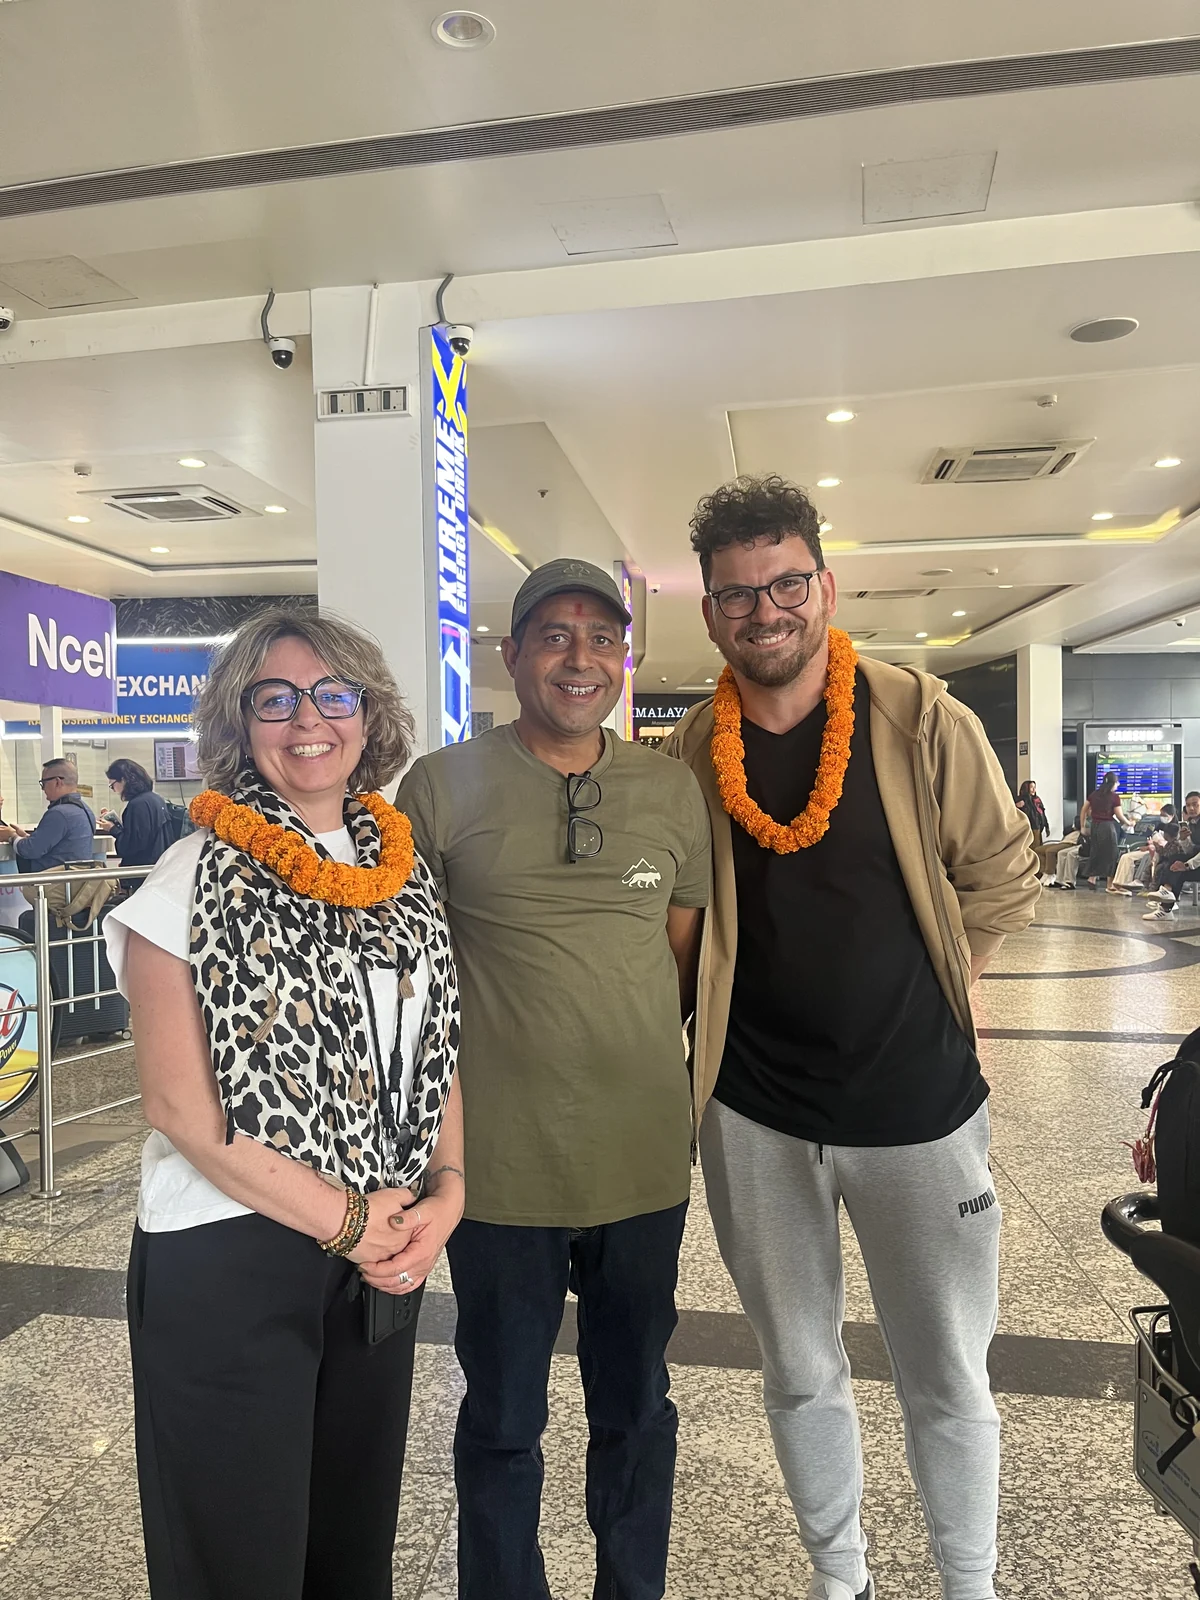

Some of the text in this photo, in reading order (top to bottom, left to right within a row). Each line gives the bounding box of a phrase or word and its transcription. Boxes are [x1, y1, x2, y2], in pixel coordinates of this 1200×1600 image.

[436, 414, 458, 611] XTREME
[453, 431, 467, 615] ENERGY DRINK
[62, 713, 194, 726] OSHAN MONEY EXCHANGE
